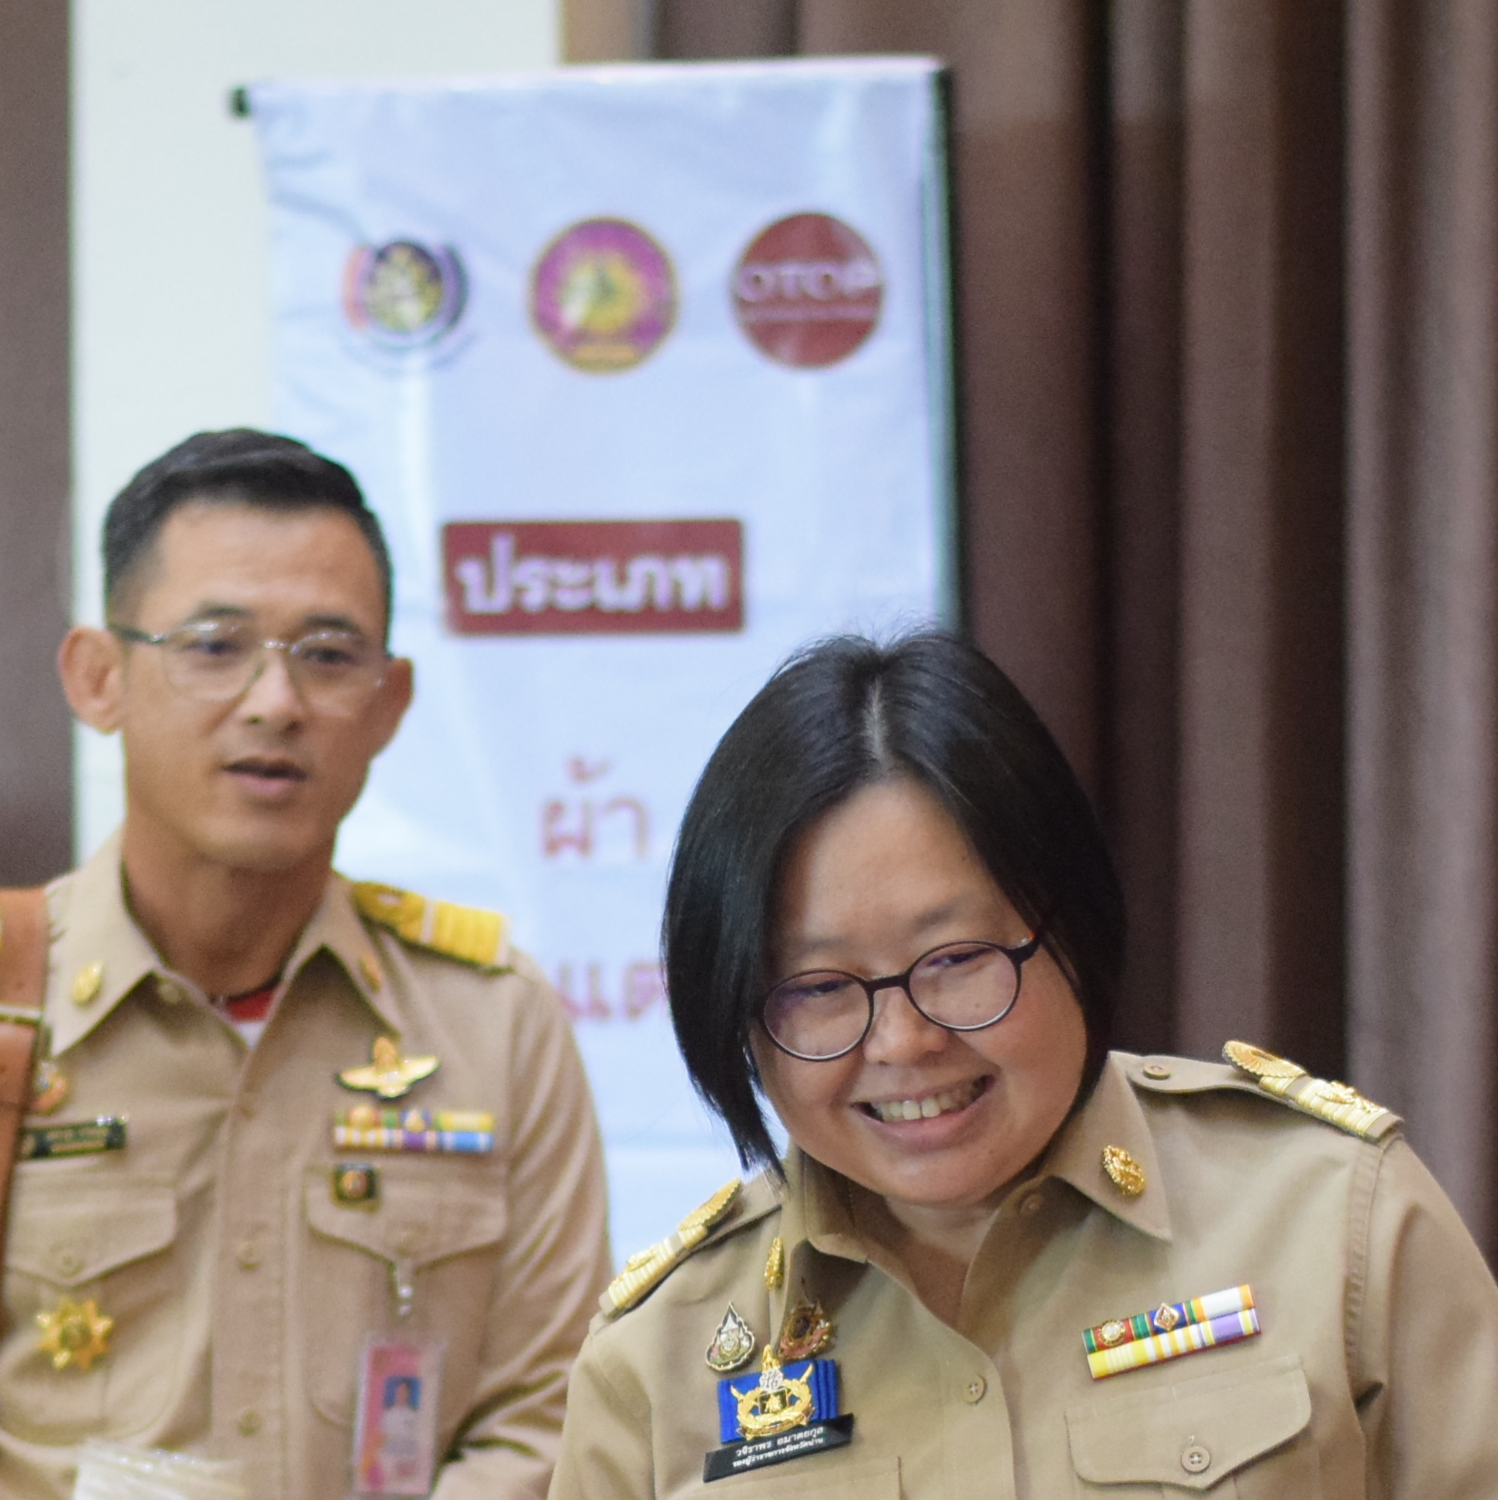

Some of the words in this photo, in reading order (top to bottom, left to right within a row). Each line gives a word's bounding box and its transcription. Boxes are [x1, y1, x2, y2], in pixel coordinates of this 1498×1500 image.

[457, 532, 728, 614] ประเภท
[542, 755, 650, 860] ผ้า
